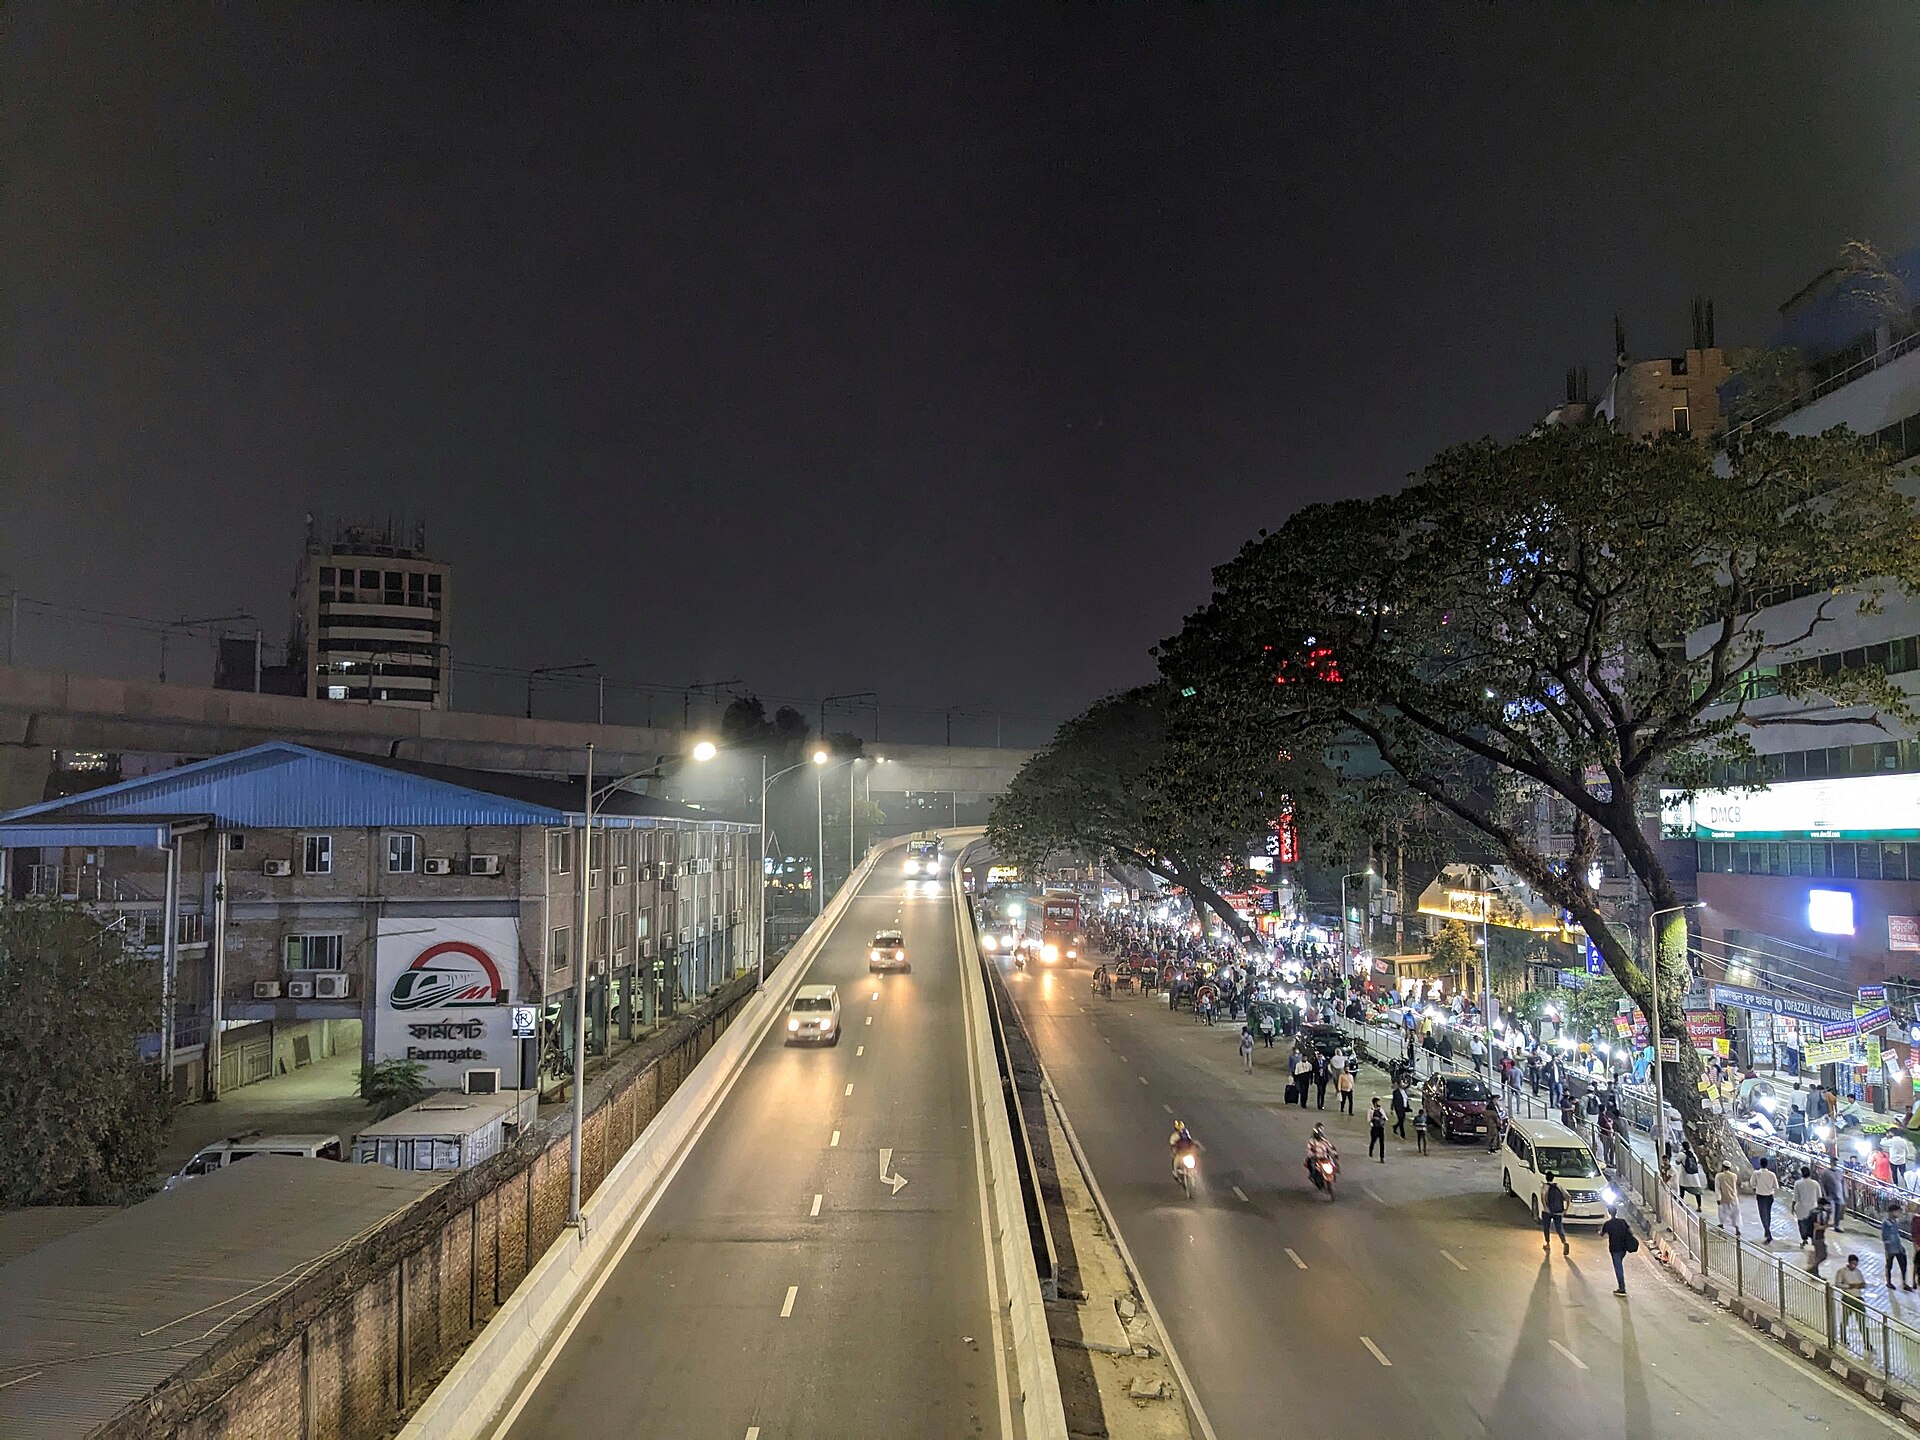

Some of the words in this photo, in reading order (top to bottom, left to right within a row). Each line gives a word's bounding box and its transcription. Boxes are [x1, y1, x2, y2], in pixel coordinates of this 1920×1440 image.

[1711, 806, 1741, 824] DMCB
[1591, 949, 1601, 972] ATM
[1744, 993, 1755, 1004] বুক
[1783, 999, 1811, 1014] TOFAZZAL
[1812, 1004, 1831, 1018] BOOK
[1831, 1008, 1852, 1021] HOUSE
[407, 1018, 483, 1041] ফার্মগেট
[407, 1046, 483, 1064] Farmgate
